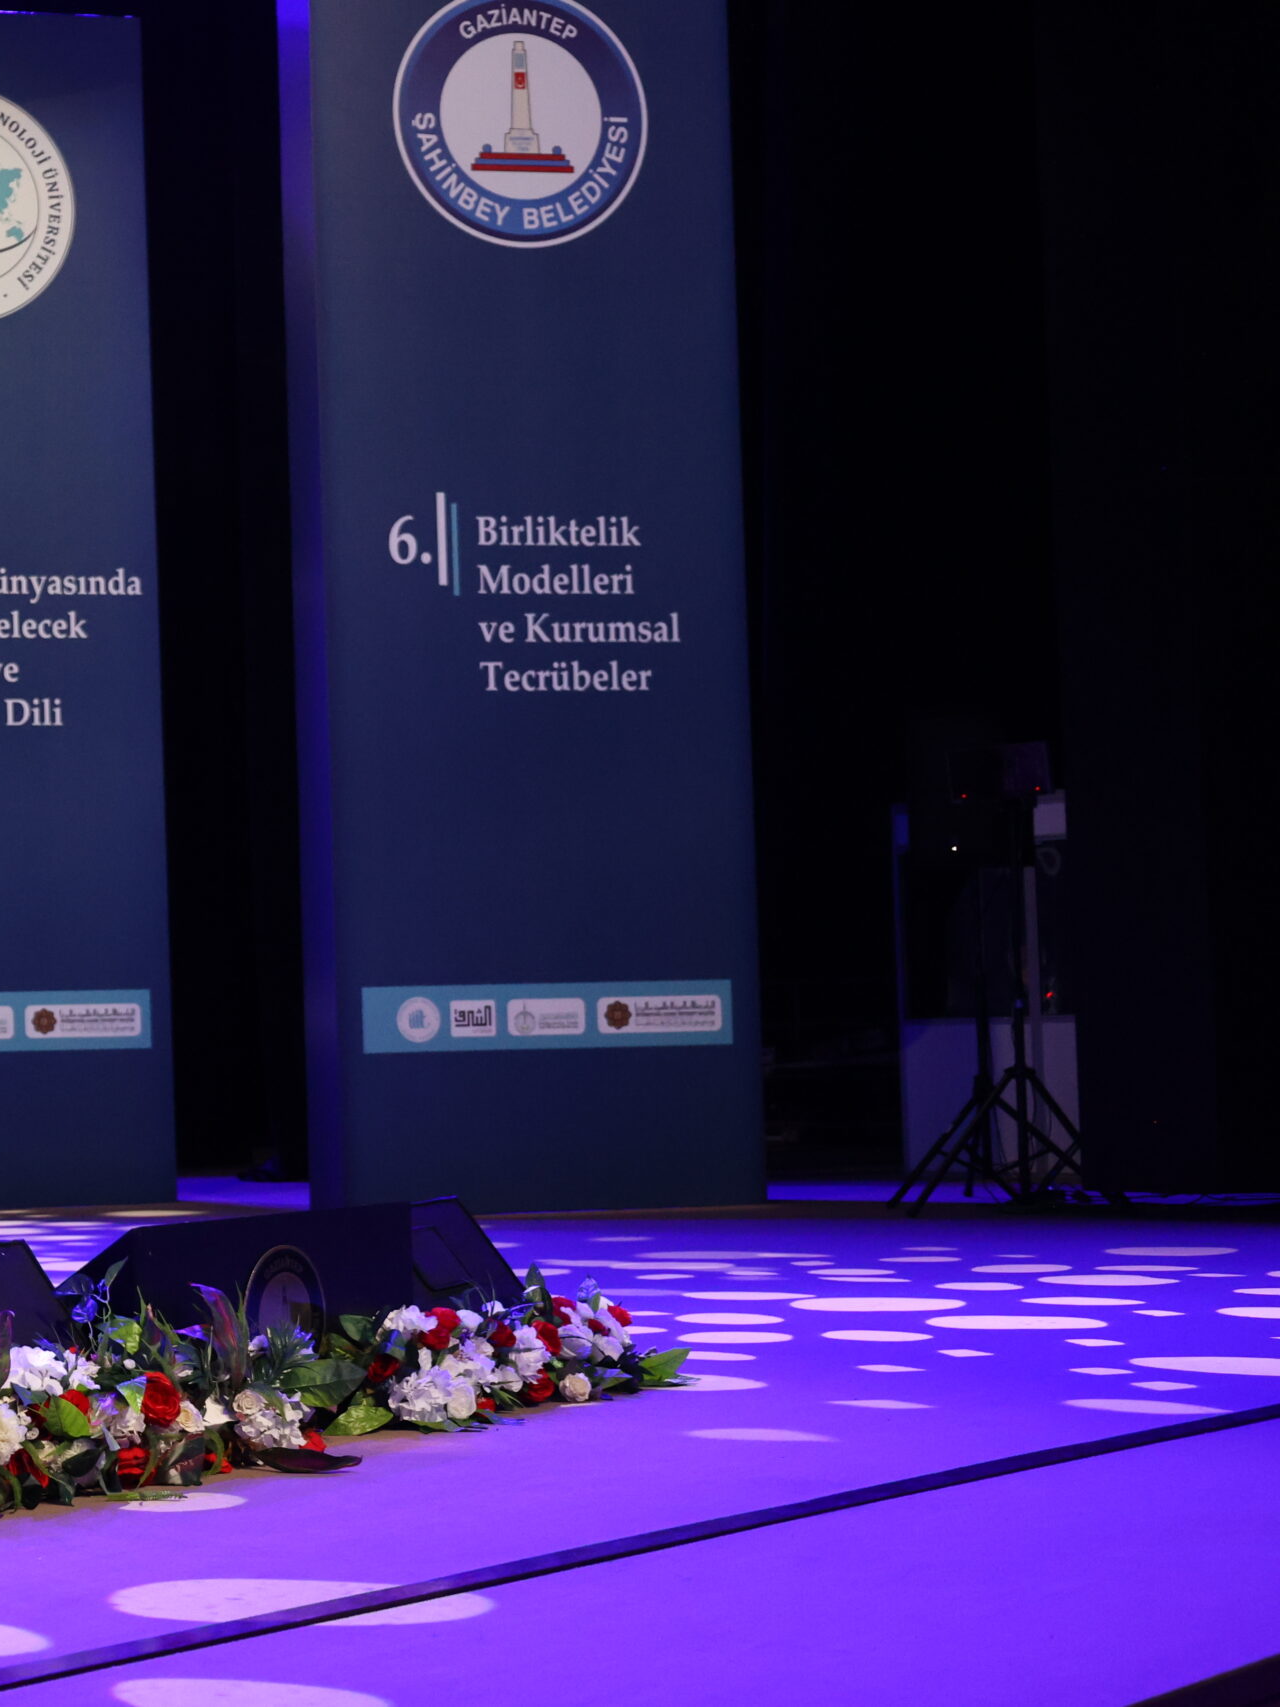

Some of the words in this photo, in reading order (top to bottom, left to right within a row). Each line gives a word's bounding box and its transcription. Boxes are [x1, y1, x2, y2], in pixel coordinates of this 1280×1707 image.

[459, 3, 578, 40] GAZİANTEP
[412, 112, 511, 226] ŞAHİNBEY
[522, 116, 628, 230] BELEDİYESİ
[17, 167, 64, 291] ÜNİVERSİTESİ
[389, 515, 431, 564] 6.
[476, 516, 641, 547] Birliktelik
[477, 564, 635, 595] Modelleri
[478, 621, 515, 643] ve
[524, 612, 680, 643] Kurumsal
[480, 660, 652, 691] Tecrübeler
[5, 698, 63, 726] Dili
